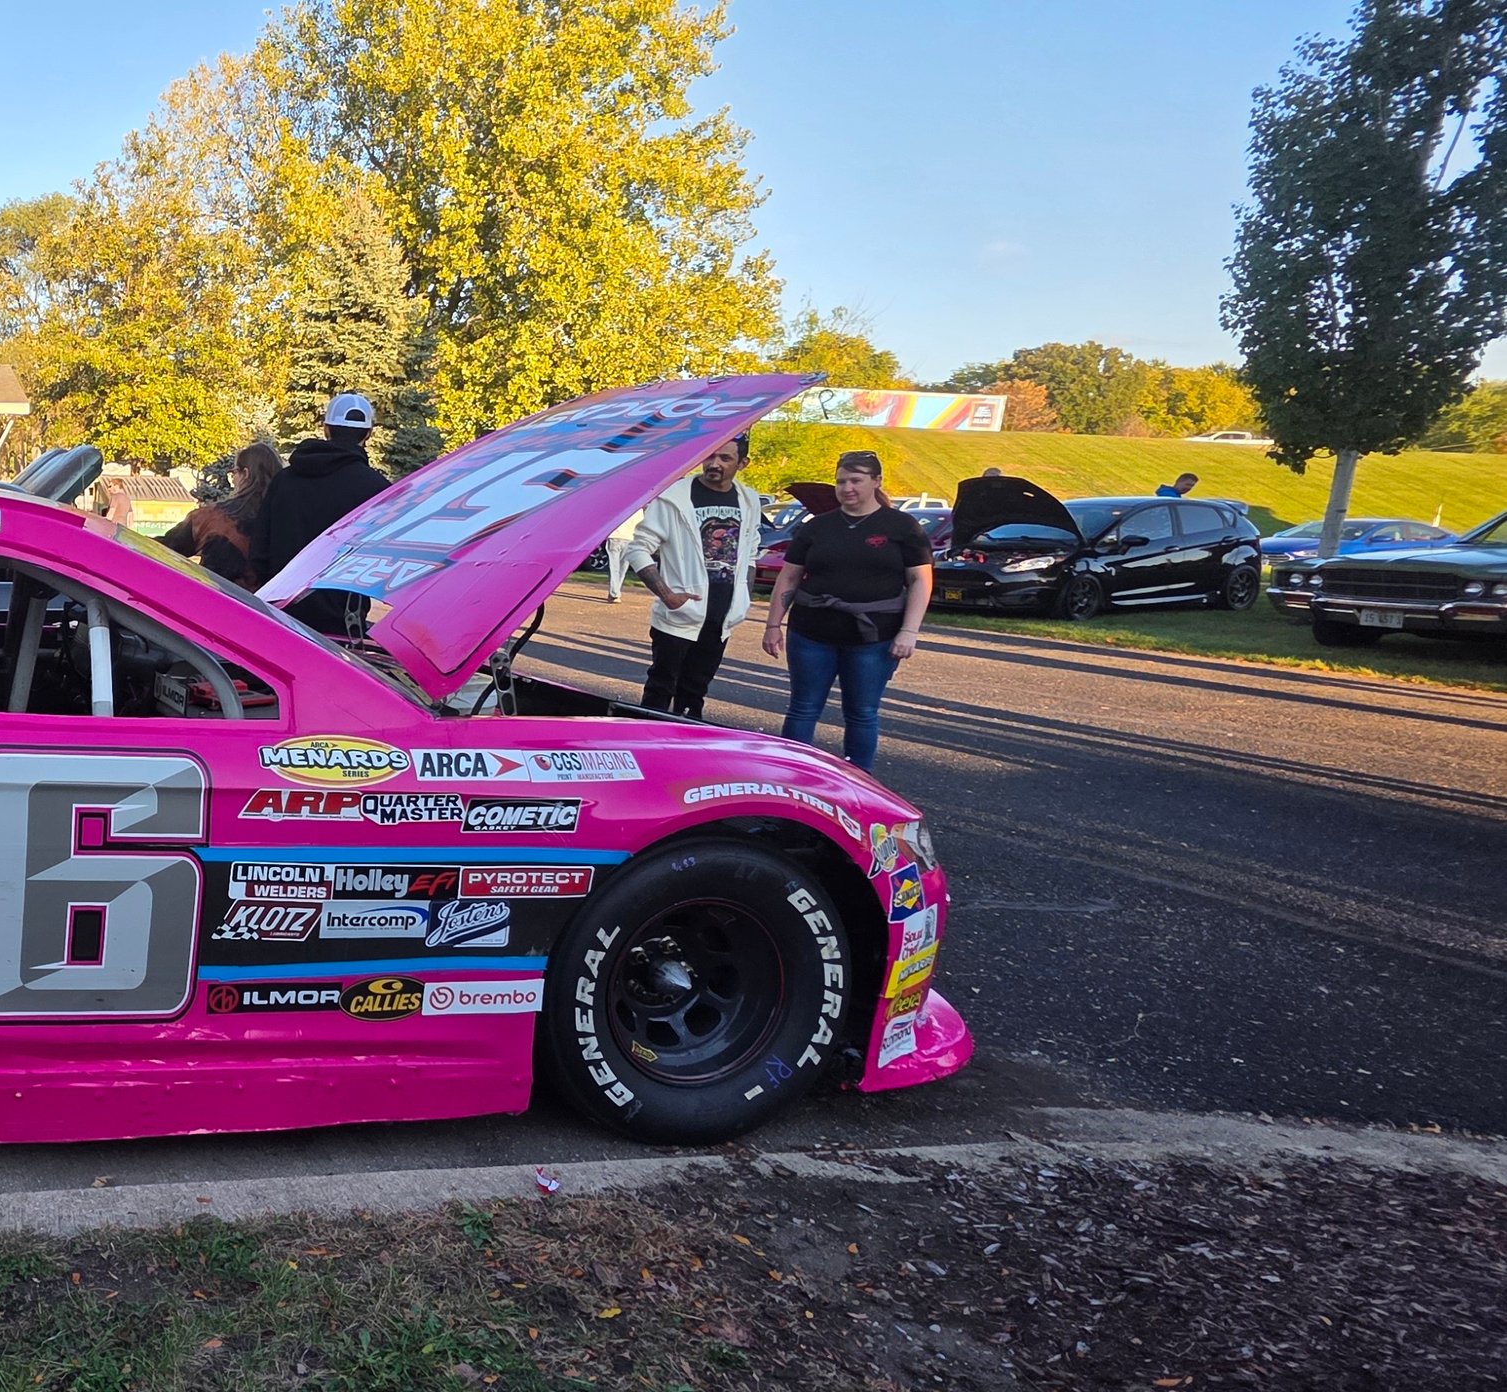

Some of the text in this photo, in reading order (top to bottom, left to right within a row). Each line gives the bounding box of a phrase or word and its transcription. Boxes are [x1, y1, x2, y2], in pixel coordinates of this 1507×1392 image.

[260, 747, 409, 770] MENARDS
[418, 752, 489, 778] ARCA
[341, 769, 370, 778] SERIES
[243, 790, 361, 815] ARP
[362, 794, 460, 816] QUARTER
[684, 783, 835, 817] GENERAL TIRE
[379, 806, 464, 824] MASTER
[467, 803, 577, 827] COMETIC
[236, 865, 321, 883] LINCOLN
[335, 867, 409, 898] Holley
[468, 871, 585, 885] PYROTECT
[253, 883, 328, 899] WELDERS
[490, 885, 559, 894] SAFETY GEAR
[230, 905, 310, 932] KLOTZ
[326, 911, 417, 930] Intercomp
[426, 900, 510, 947] Jostens
[786, 888, 844, 1068] GENERAL
[243, 989, 341, 1006] ILMOR
[350, 991, 422, 1013] CALLIES
[459, 987, 537, 1006] brembo
[575, 925, 634, 1107] GENERAL
